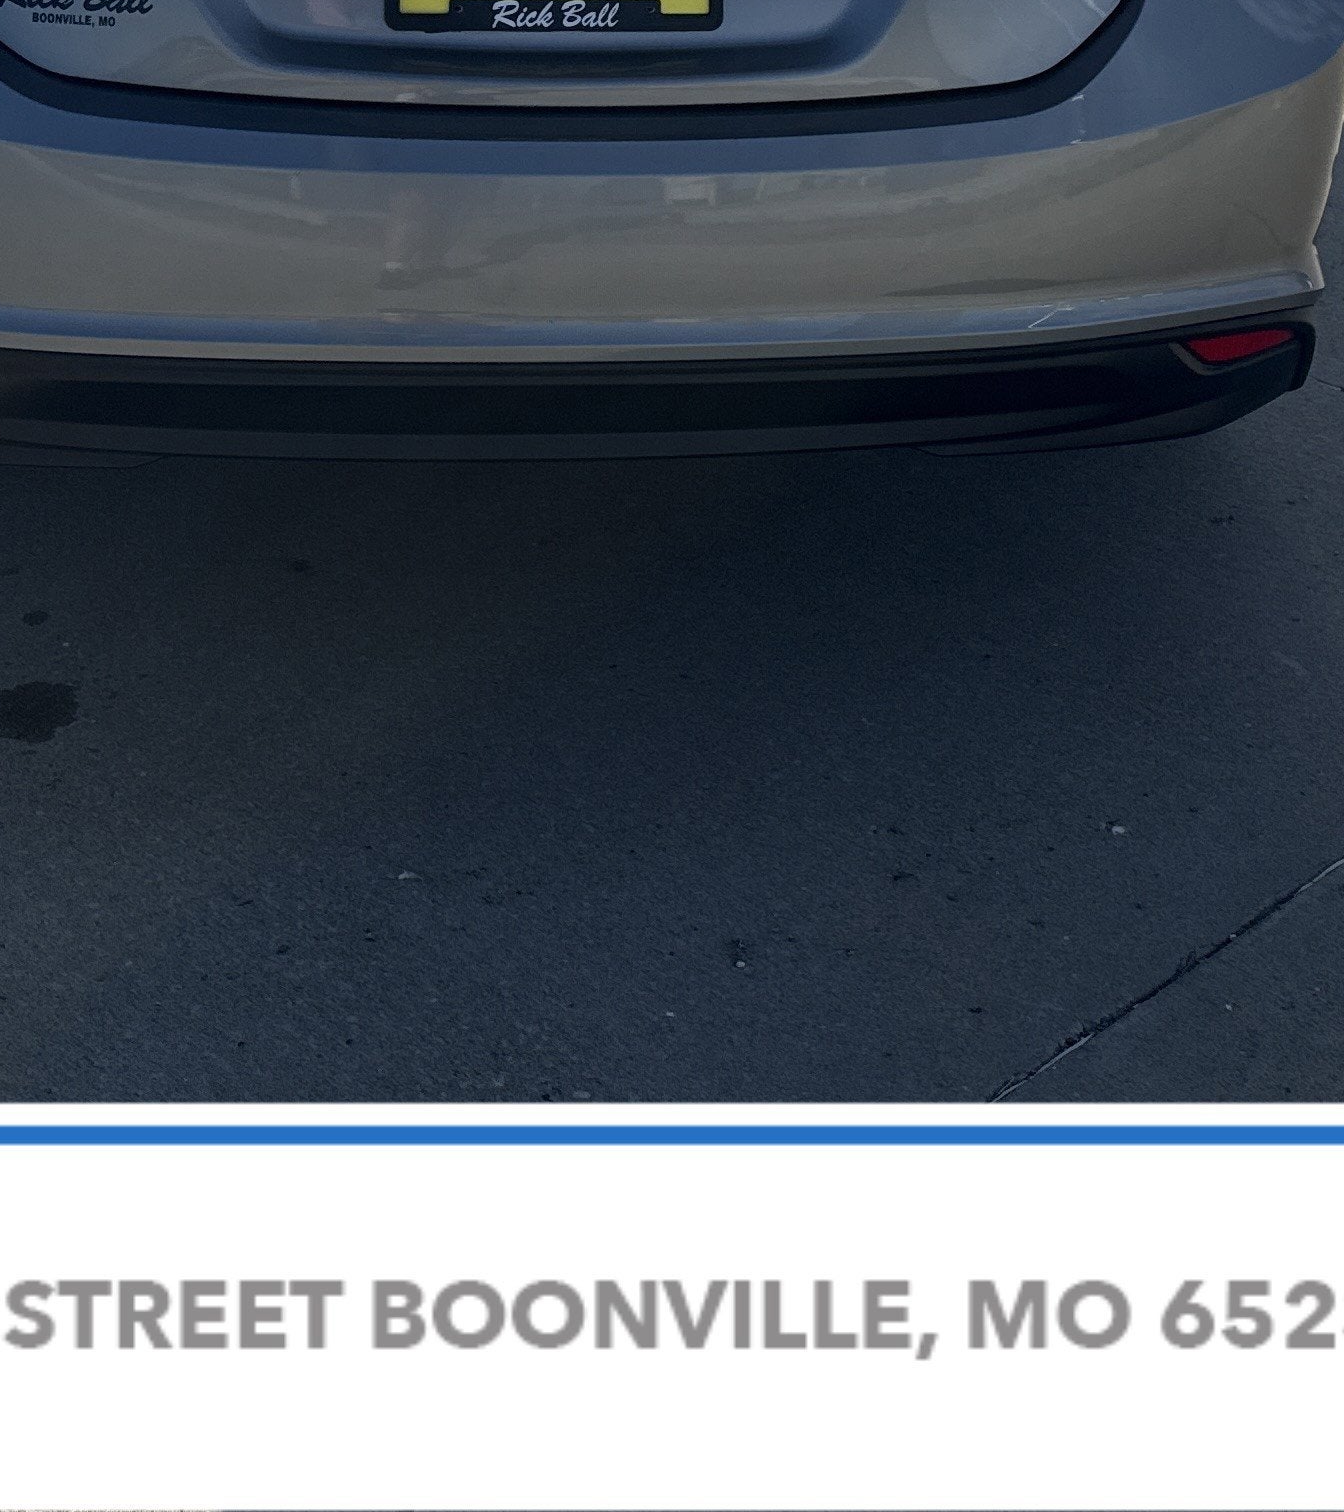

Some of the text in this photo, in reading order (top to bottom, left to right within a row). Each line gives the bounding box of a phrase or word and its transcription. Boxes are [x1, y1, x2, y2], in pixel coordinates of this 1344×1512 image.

[32, 12, 116, 28] BOONVILLE, MO
[492, 0, 620, 29] Rick Ball
